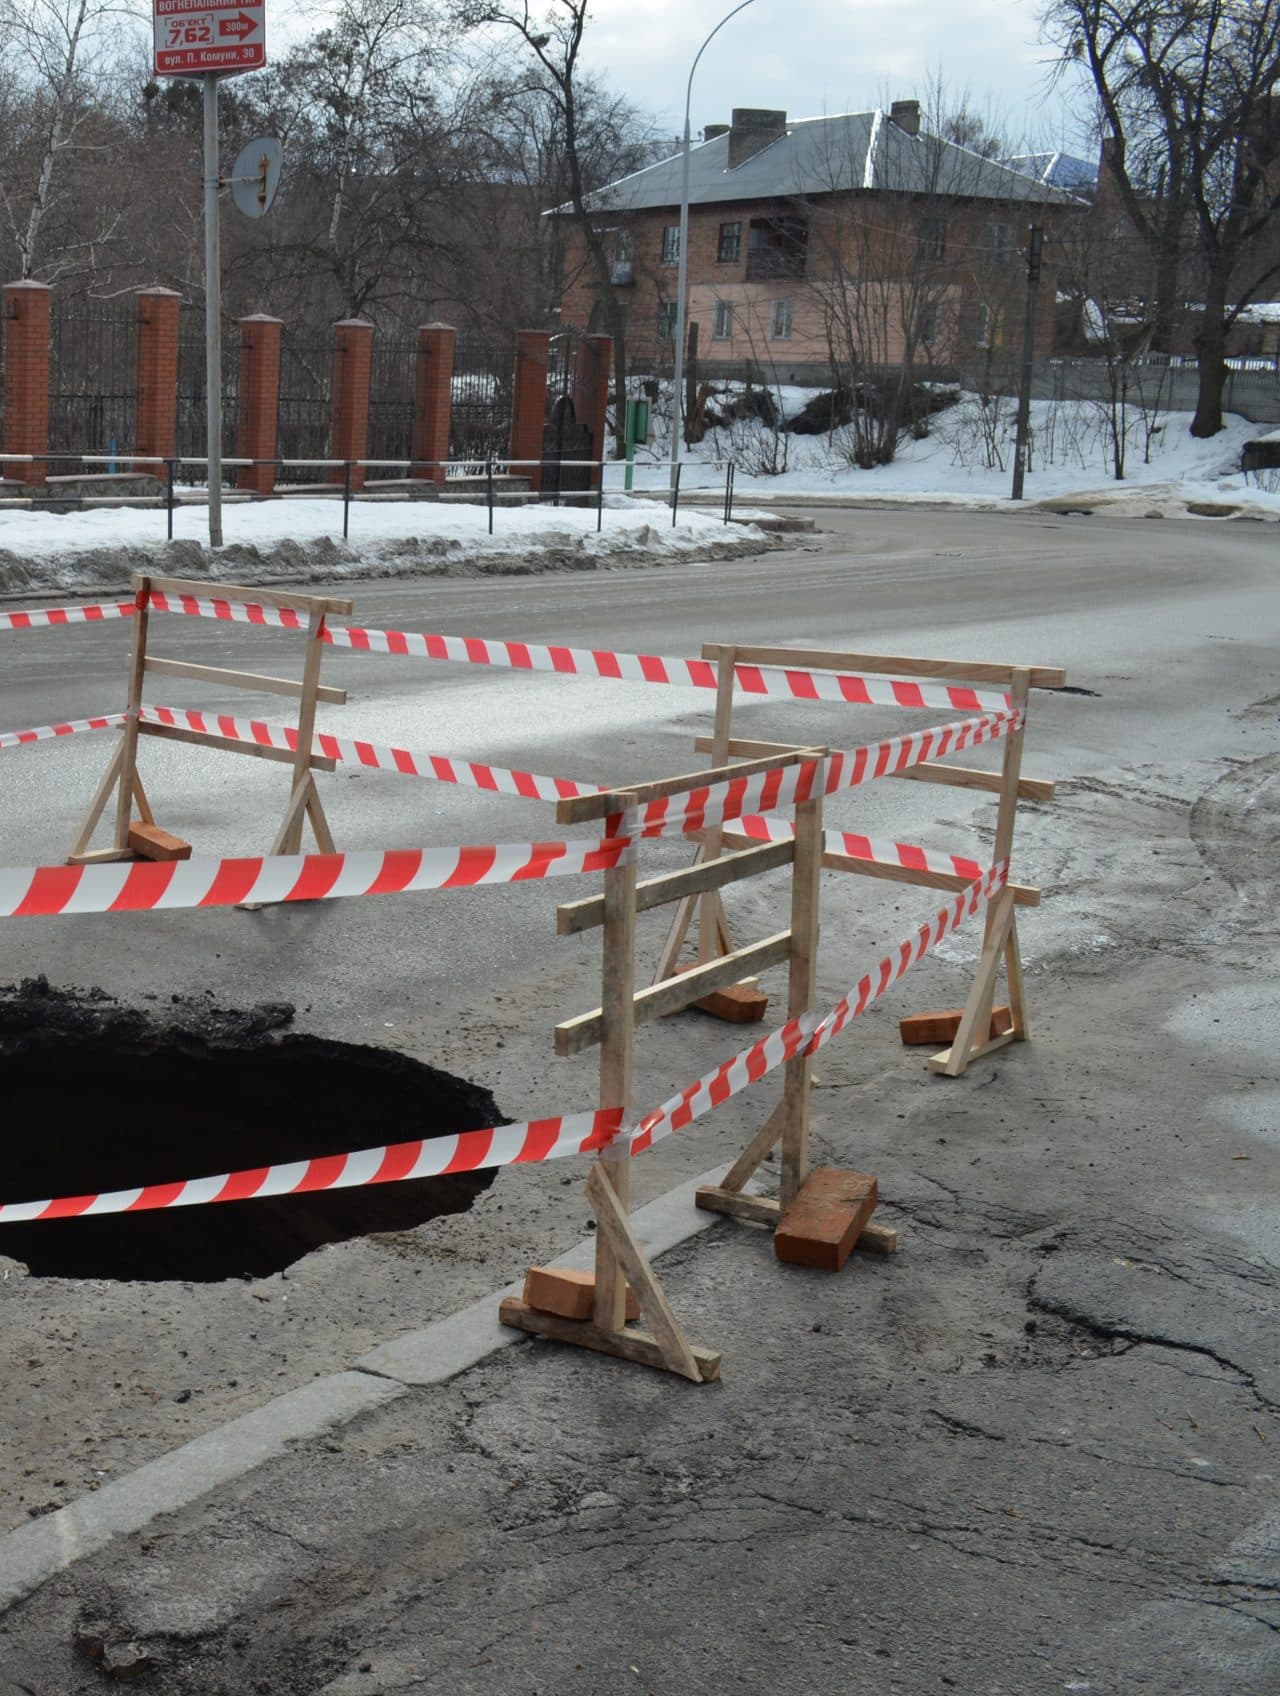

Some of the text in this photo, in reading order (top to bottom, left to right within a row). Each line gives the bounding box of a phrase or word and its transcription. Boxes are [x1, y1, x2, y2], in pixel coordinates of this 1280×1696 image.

[168, 26, 211, 46] 7,62
[165, 47, 255, 66] вул. П. Комуни, 30
